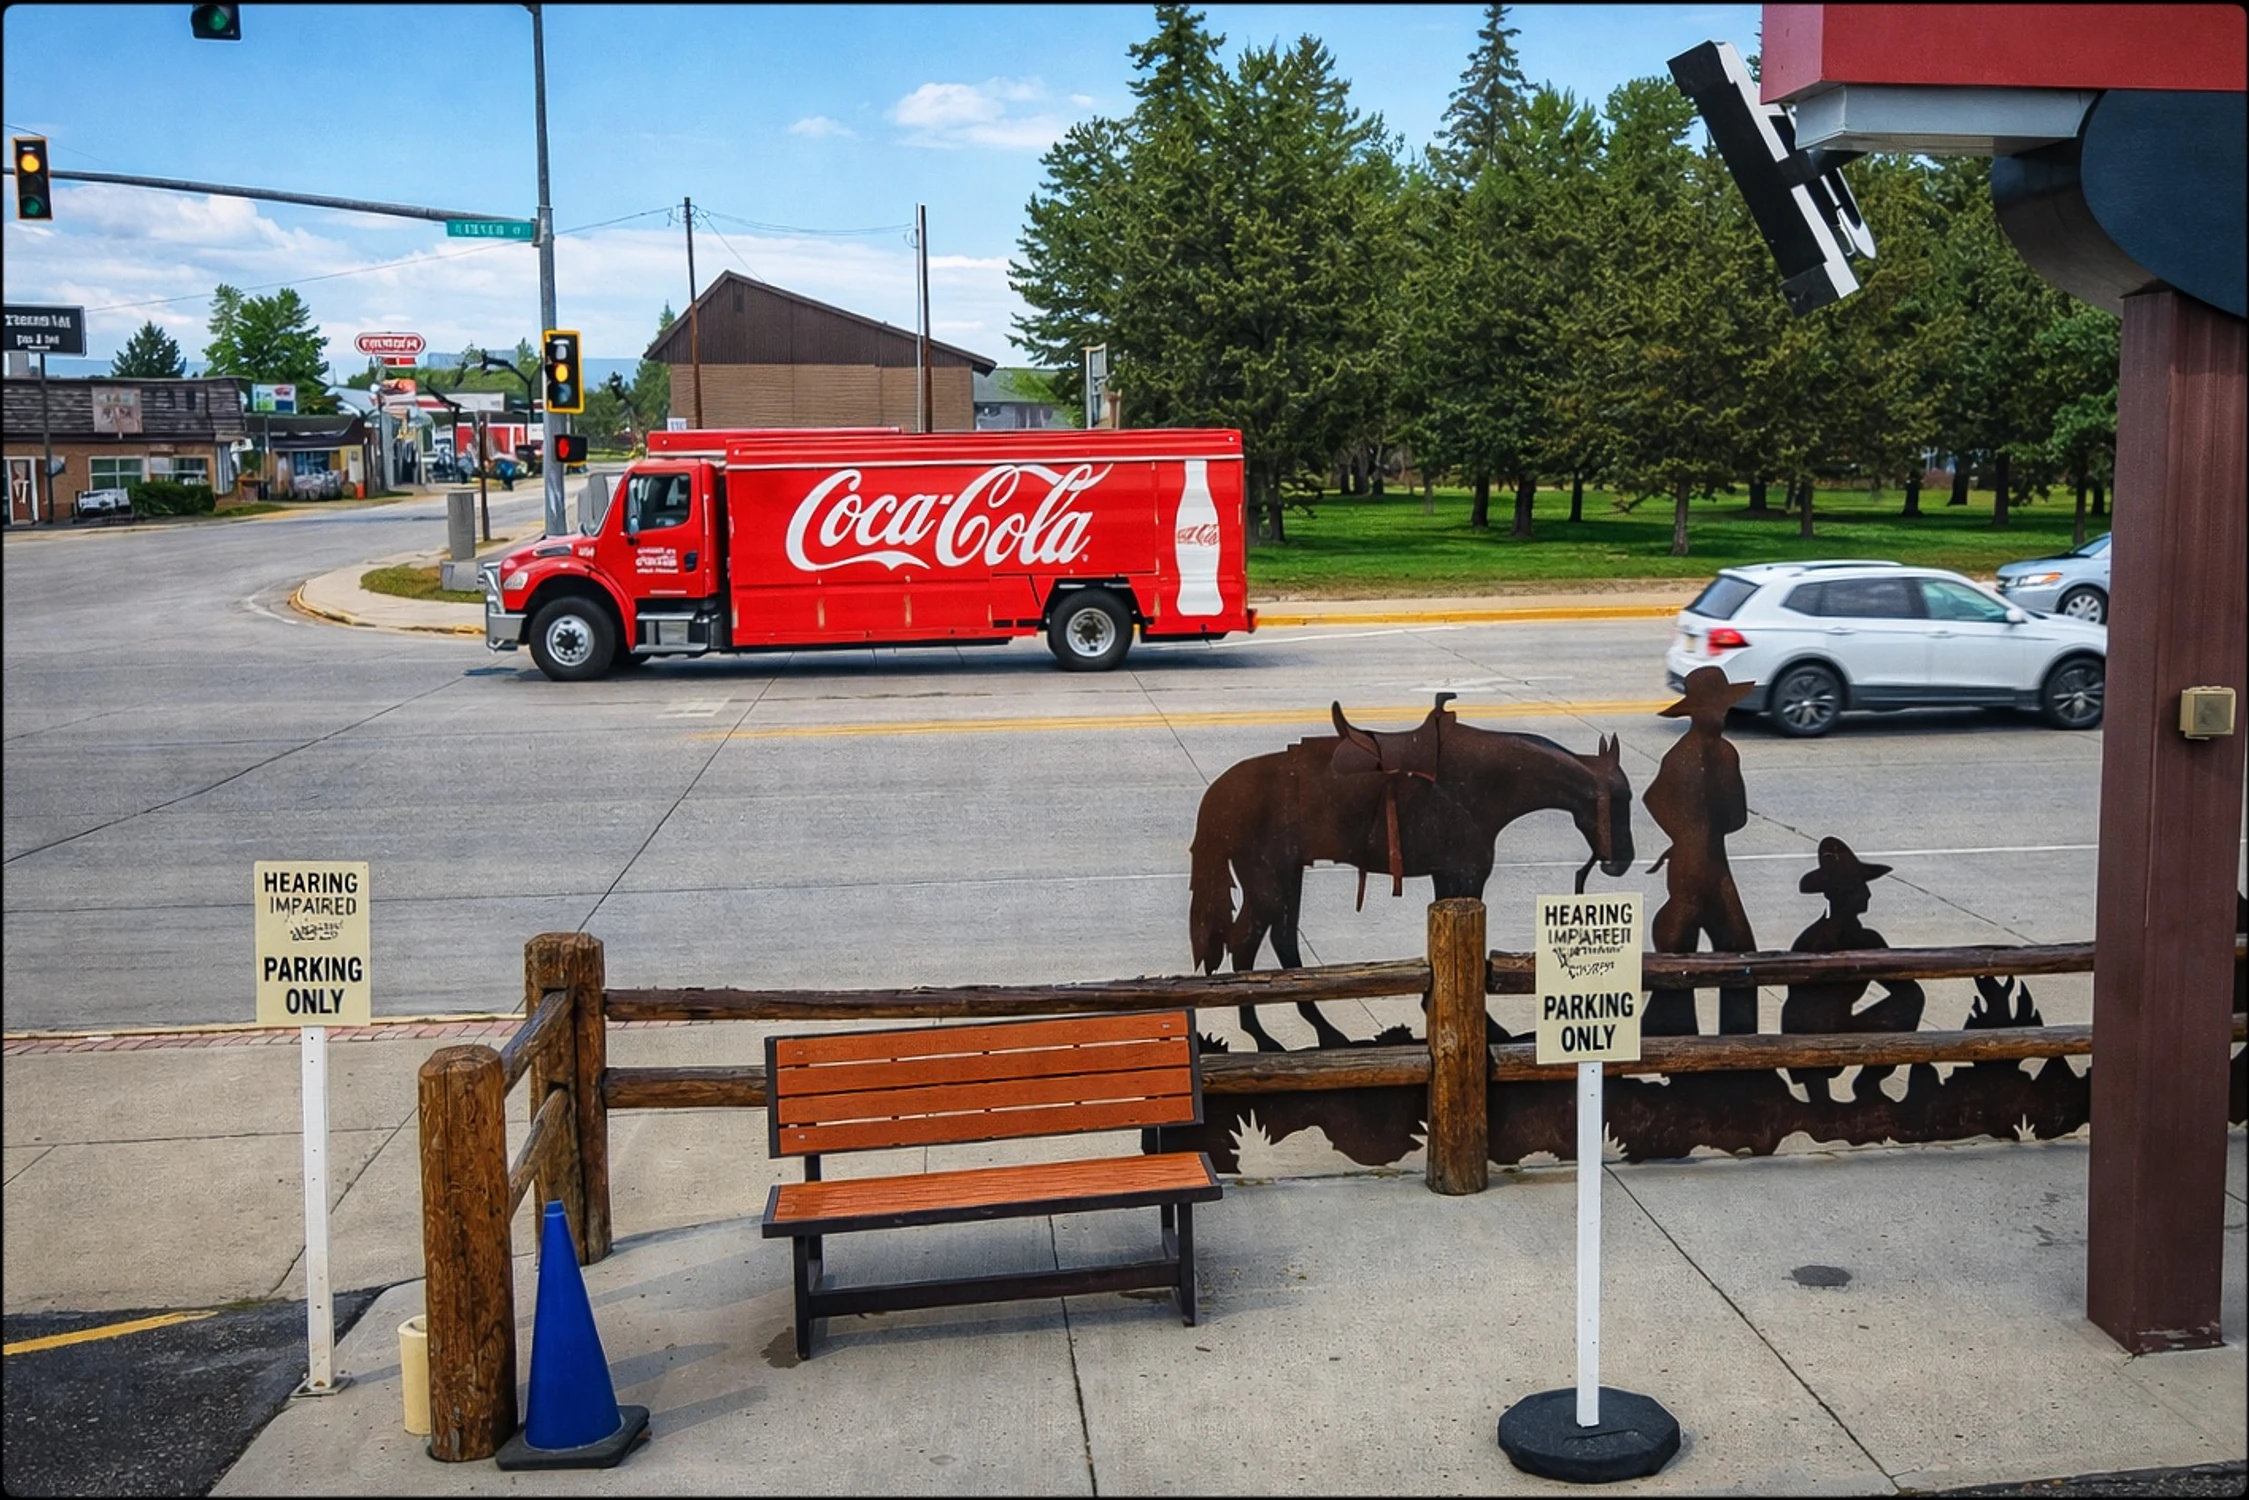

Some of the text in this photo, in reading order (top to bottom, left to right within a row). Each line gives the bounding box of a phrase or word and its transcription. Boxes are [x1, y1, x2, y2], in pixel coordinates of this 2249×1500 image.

[785, 463, 1114, 571] Coca-Cola
[264, 873, 358, 893] HEARING
[270, 897, 357, 915] IMPAIRED
[1545, 904, 1633, 926] HEARING
[264, 957, 362, 982] PARKING
[286, 989, 344, 1014] ONLY
[1544, 992, 1634, 1020] PARKING
[1561, 1024, 1617, 1052] ONLY
